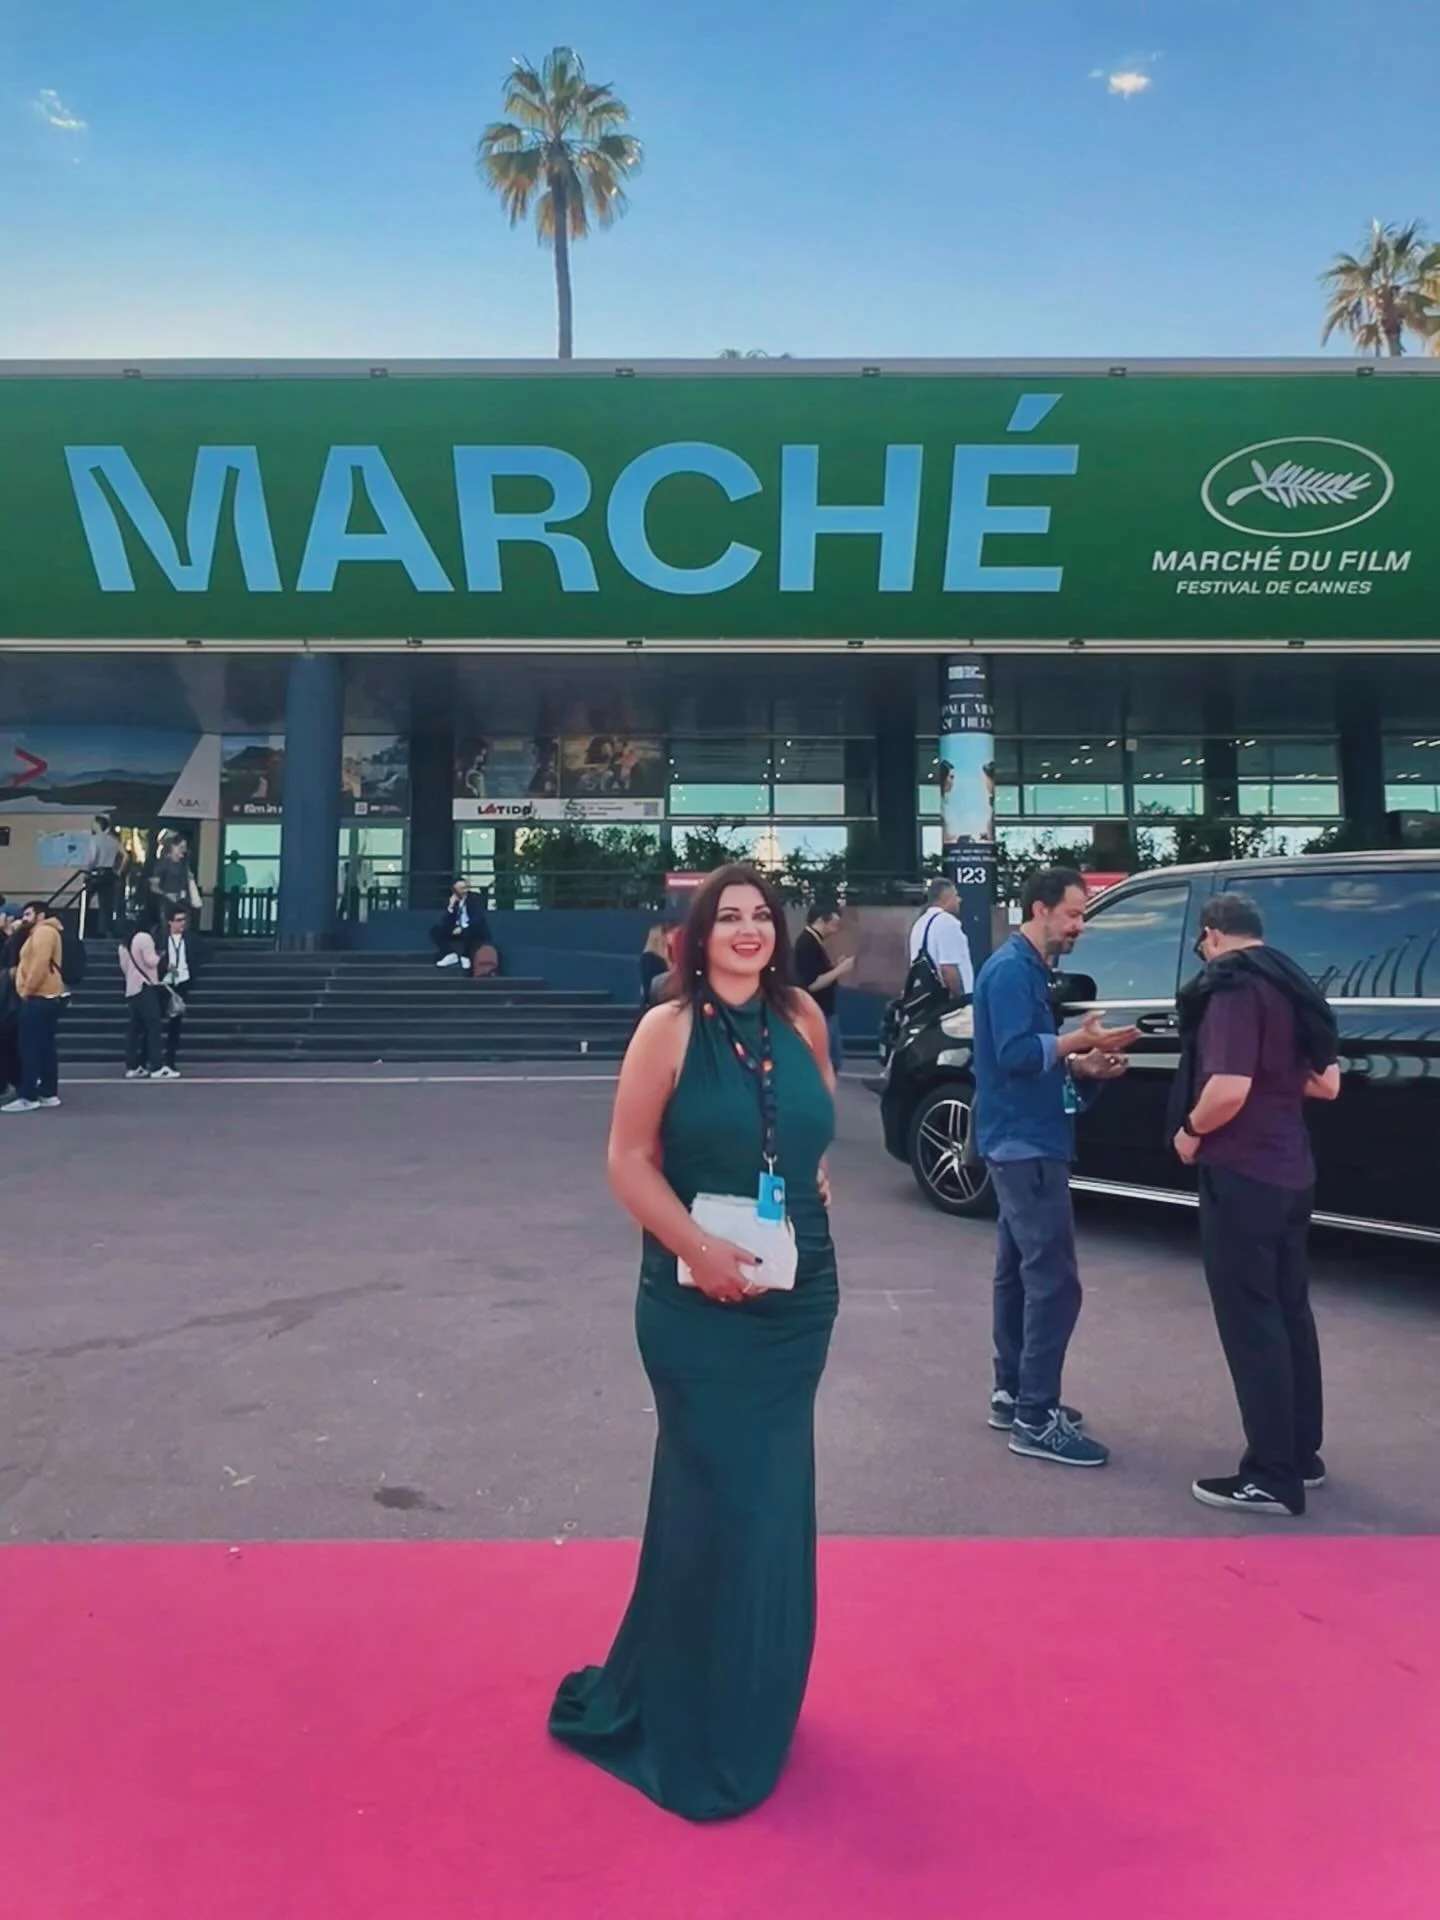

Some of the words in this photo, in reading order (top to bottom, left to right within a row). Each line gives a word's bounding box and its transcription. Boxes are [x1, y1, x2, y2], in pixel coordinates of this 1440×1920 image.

[65, 394, 1079, 593] MARCHÉ
[1152, 545, 1280, 571] MARCHÉ
[1289, 551, 1331, 571] DU
[1338, 551, 1411, 571] FILM
[1176, 581, 1261, 594] FESTIVAL
[1265, 581, 1290, 594] DE
[1294, 581, 1371, 594] CANNES
[957, 867, 986, 884] 123
